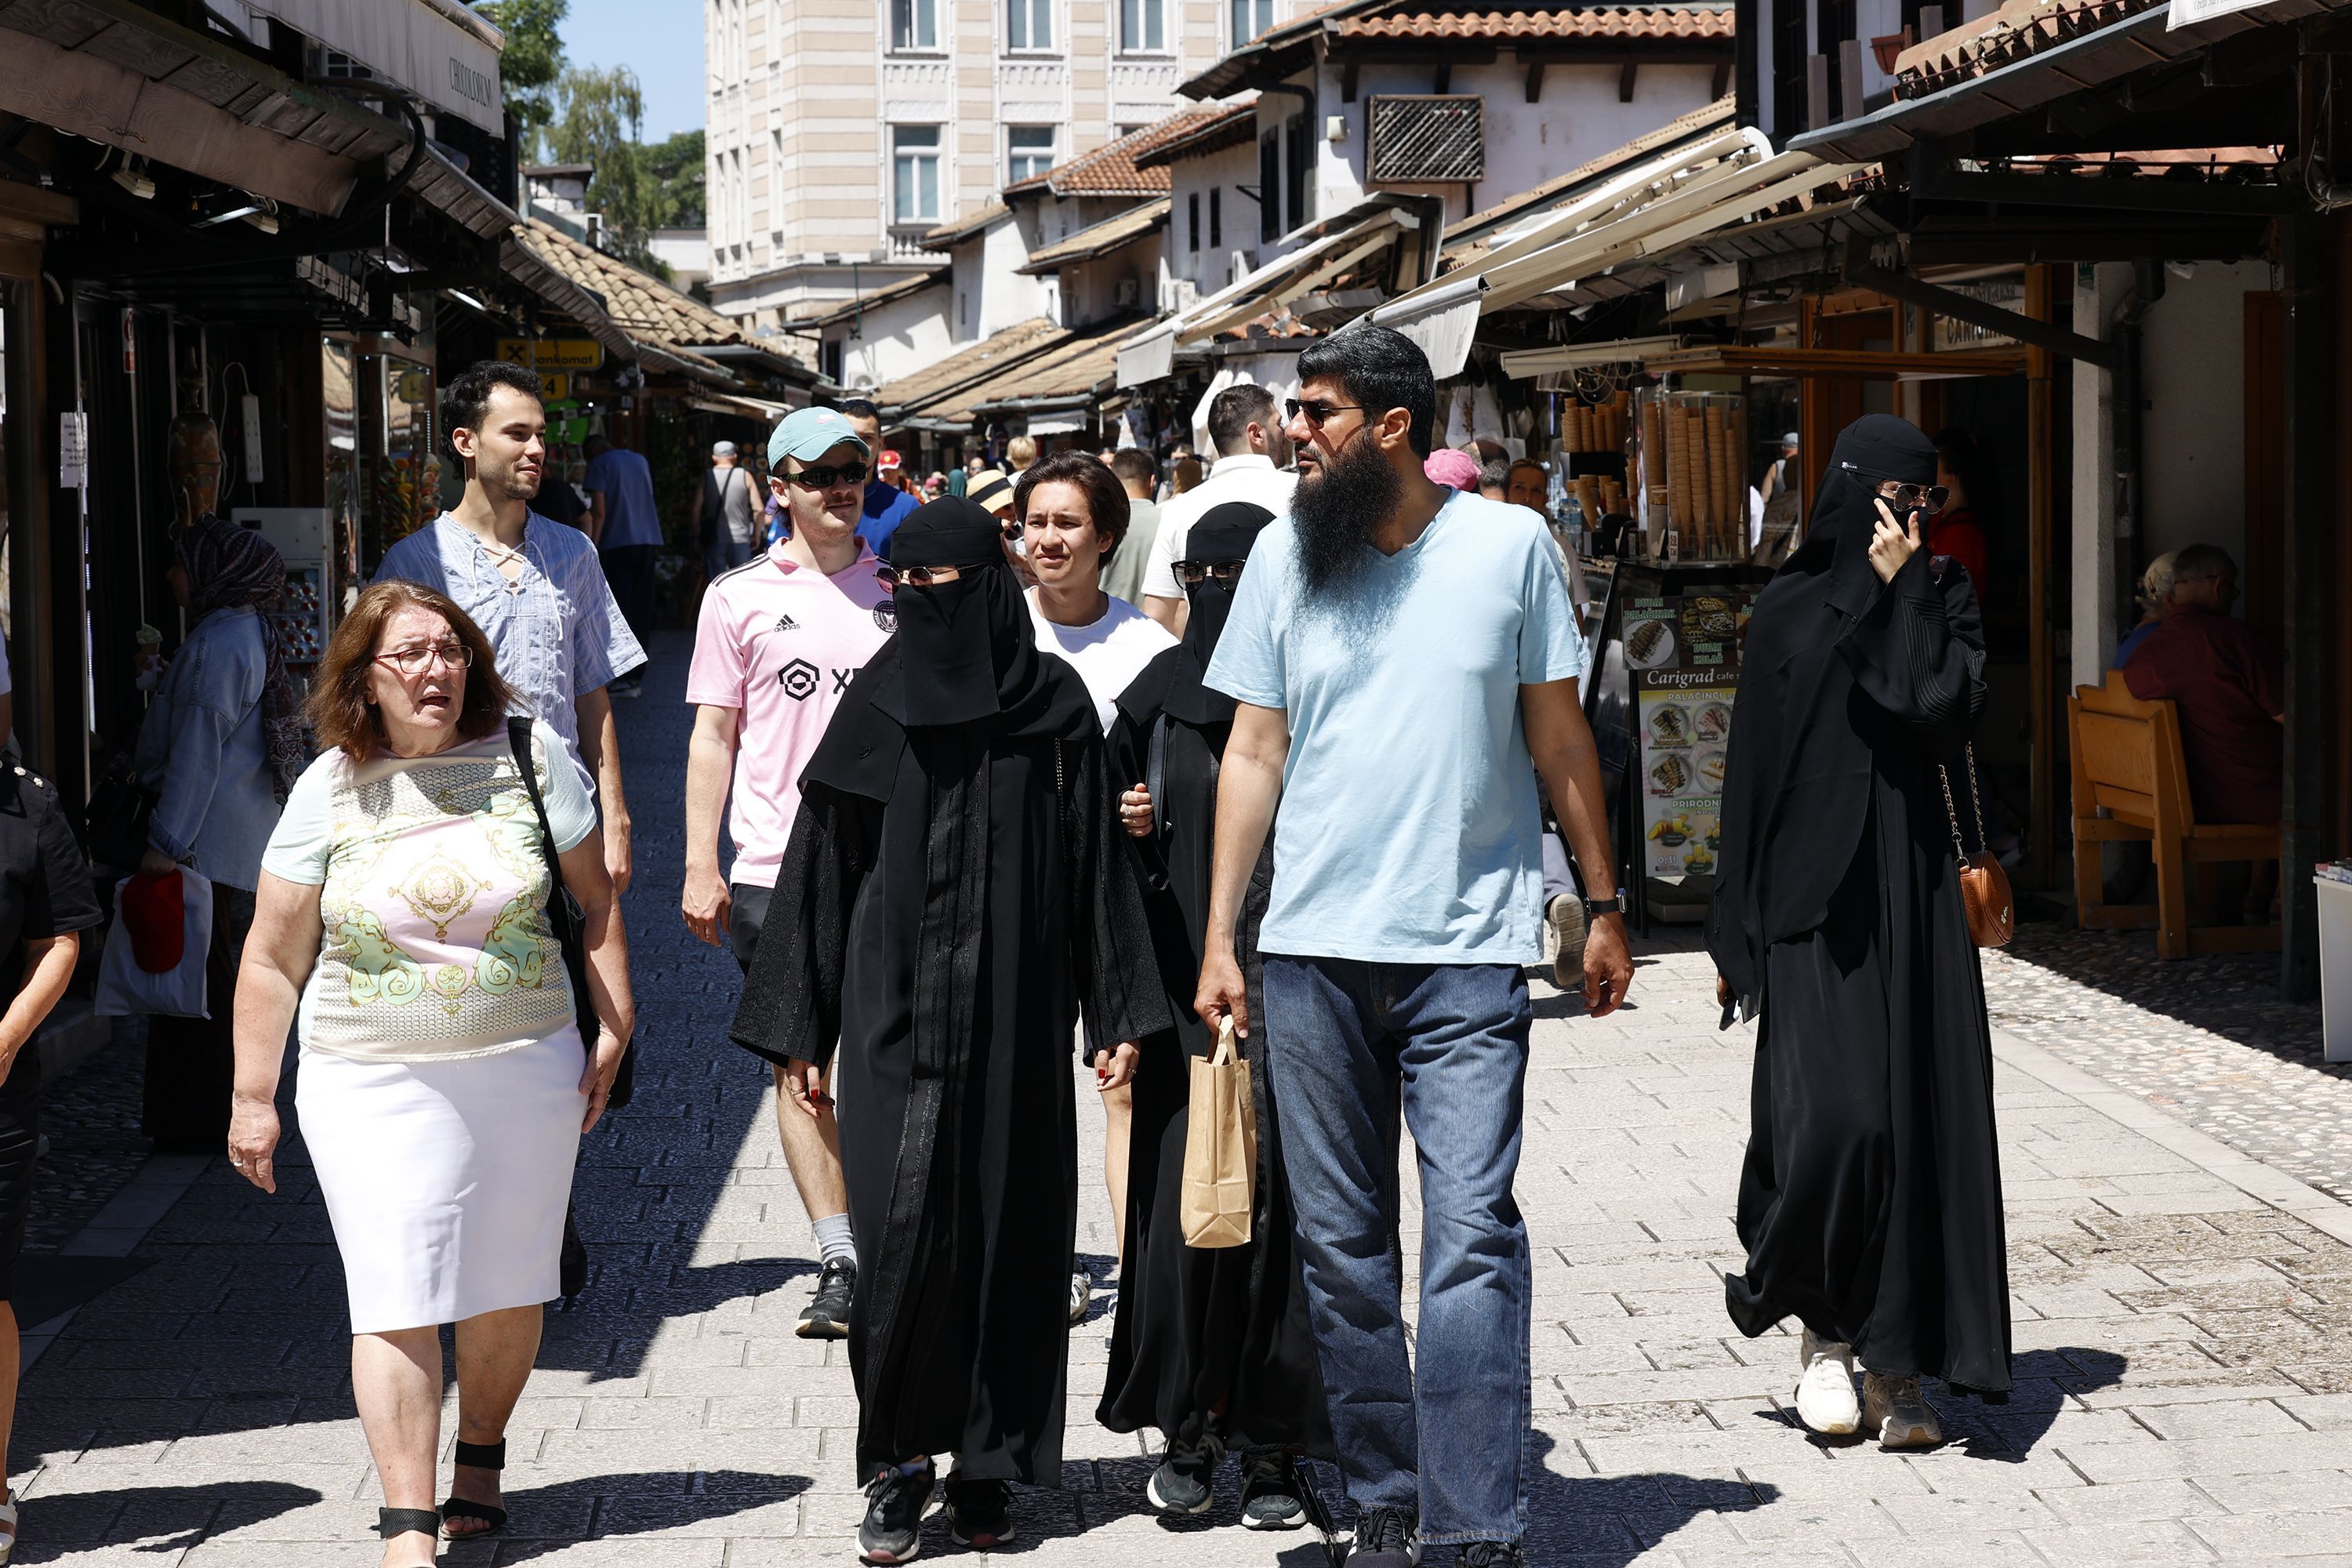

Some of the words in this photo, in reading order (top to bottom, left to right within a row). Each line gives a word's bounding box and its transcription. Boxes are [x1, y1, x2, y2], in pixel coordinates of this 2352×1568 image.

[1635, 597, 1664, 608] DUBAI
[1624, 607, 1676, 620] PALAČINAK
[774, 623, 801, 633] adidas
[1693, 643, 1722, 652] DUBAI
[1693, 652, 1723, 665] KOLAČ
[1647, 667, 1715, 688] Carigrad
[1716, 671, 1734, 681] cafe
[1668, 691, 1722, 701] PALAČINCI
